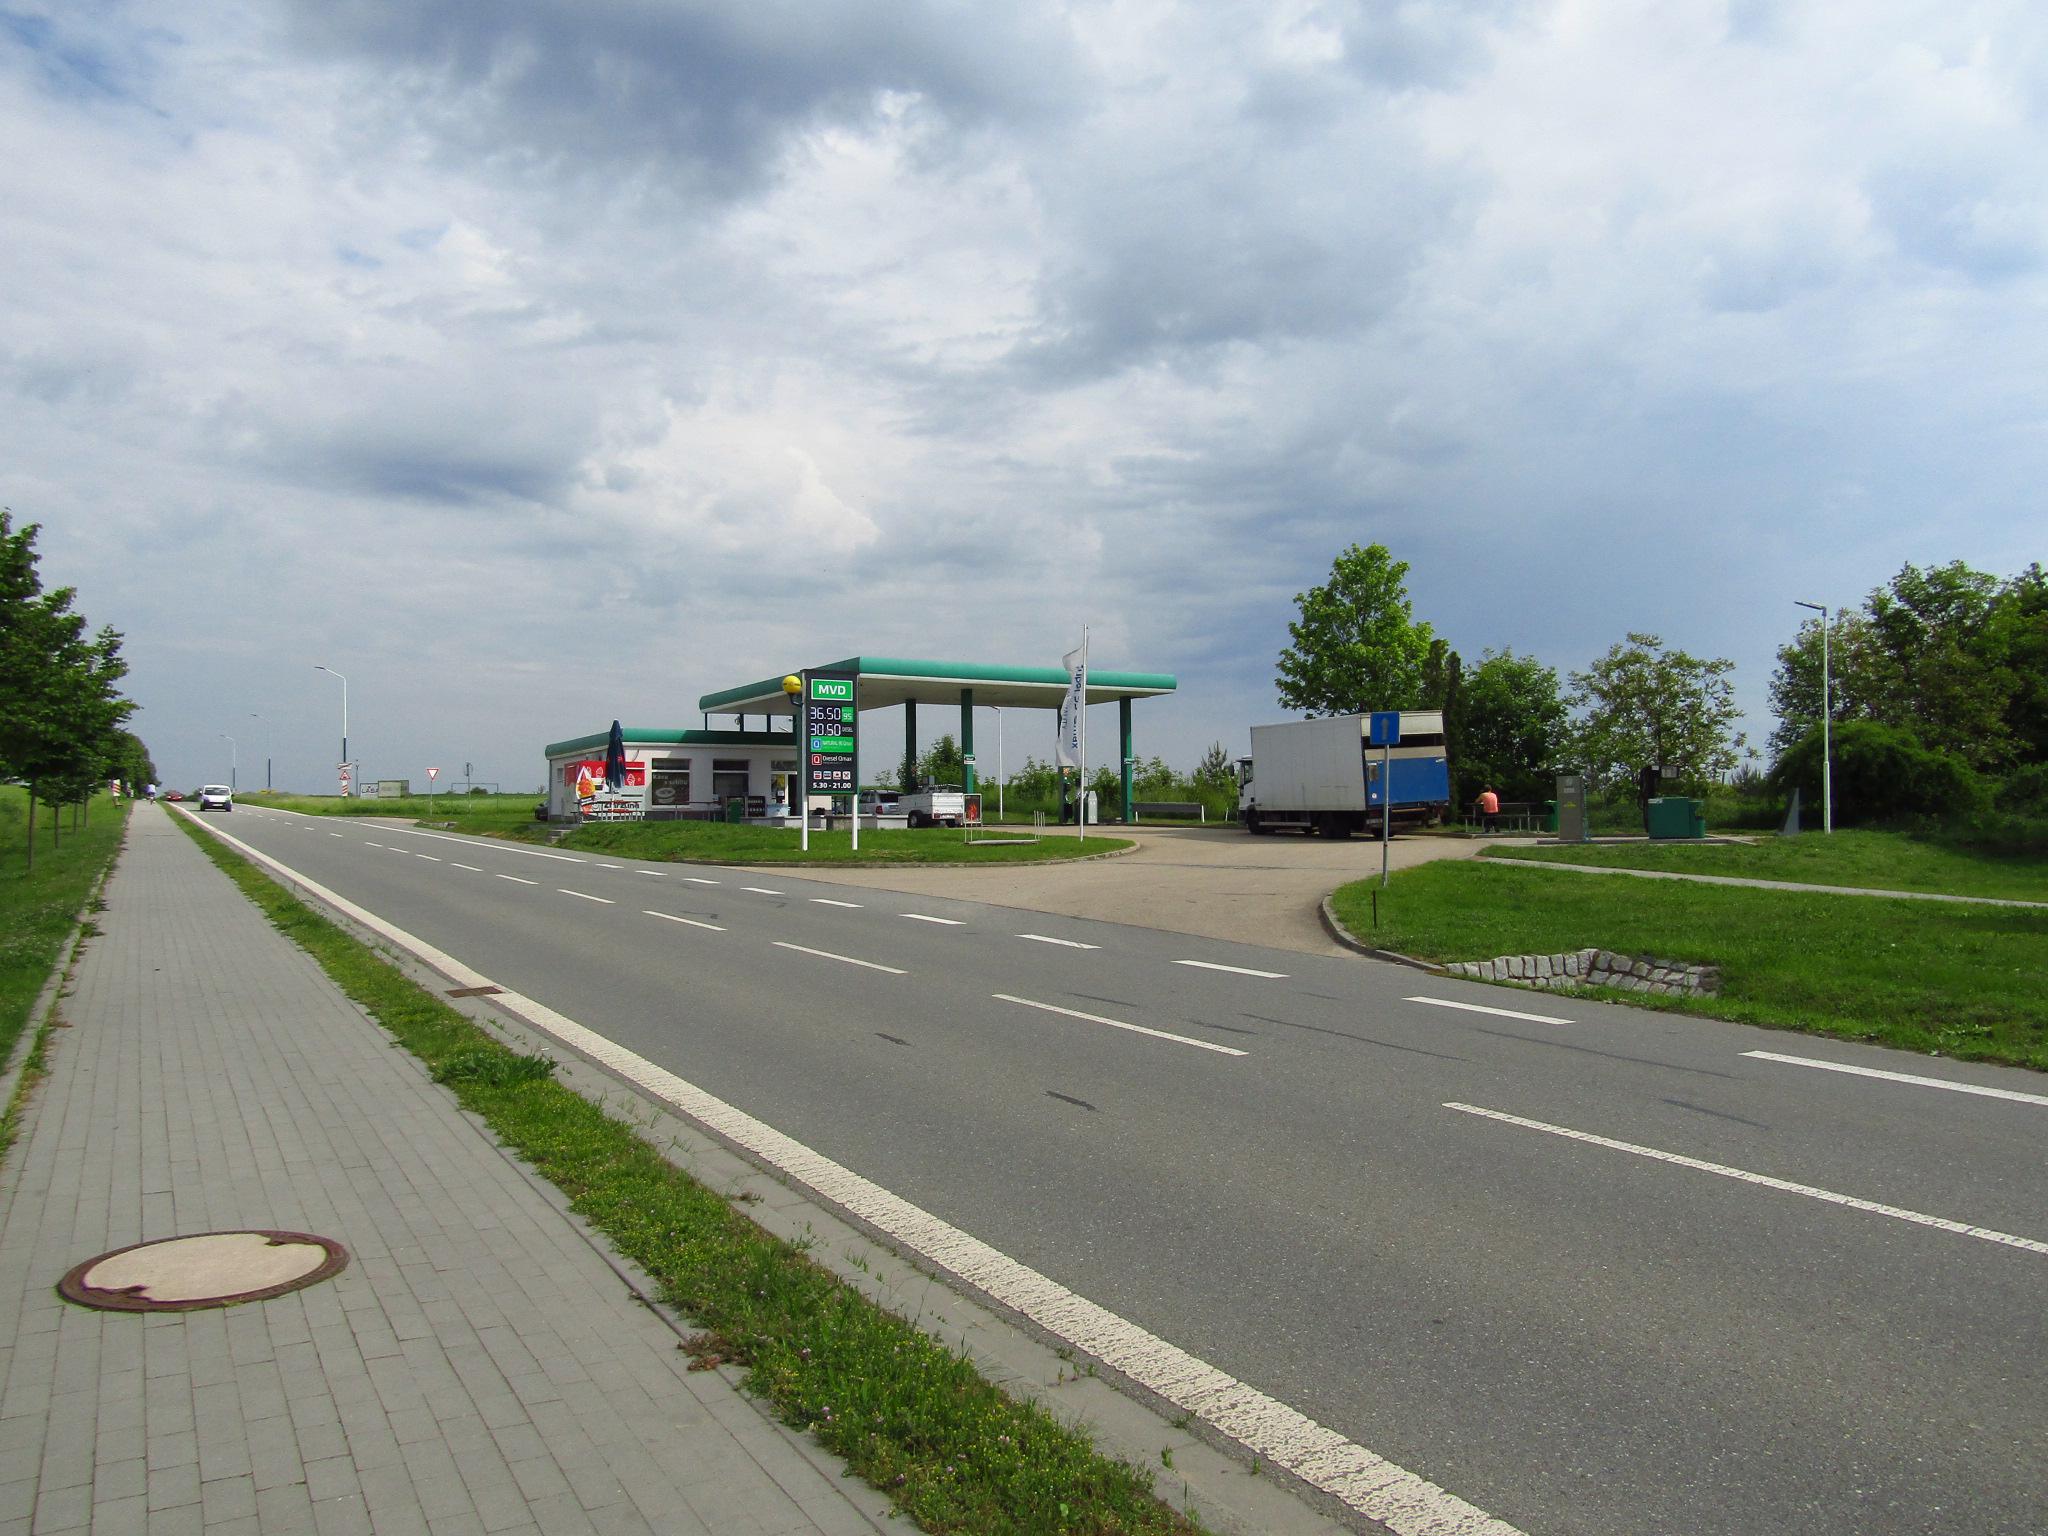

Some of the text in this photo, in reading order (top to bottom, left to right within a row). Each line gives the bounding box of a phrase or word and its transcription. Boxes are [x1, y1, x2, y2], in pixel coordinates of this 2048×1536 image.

[818, 684, 846, 695] MVD
[810, 706, 841, 720] 36.50
[810, 722, 841, 736] 30.50
